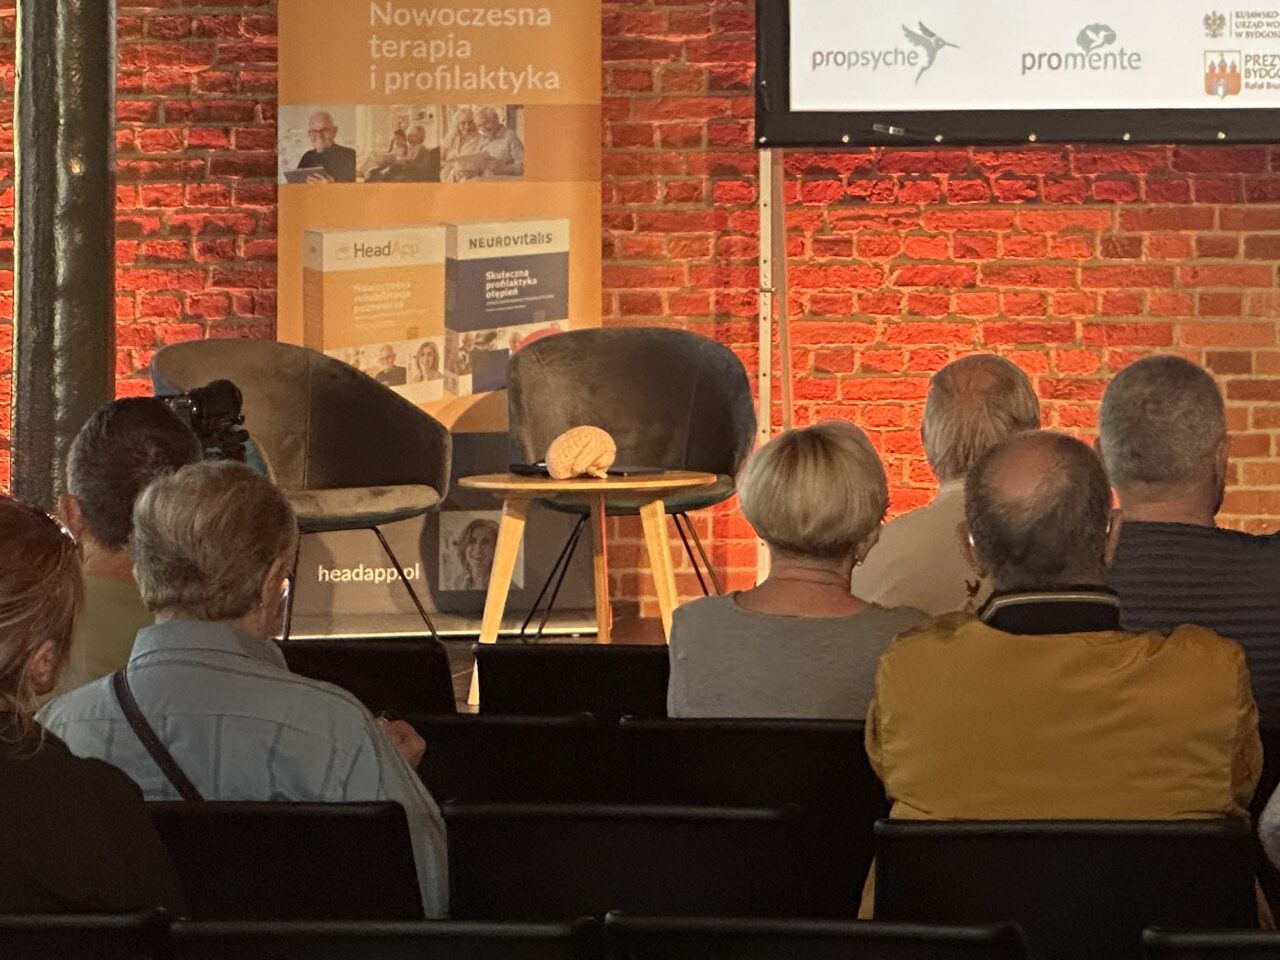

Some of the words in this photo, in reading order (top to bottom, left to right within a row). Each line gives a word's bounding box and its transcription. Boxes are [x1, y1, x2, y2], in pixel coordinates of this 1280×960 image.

[369, 1, 551, 27] Nowoczesna
[369, 34, 472, 62] terapia
[812, 48, 919, 71] propsyche
[1021, 46, 1142, 76] promente
[369, 65, 376, 89] i
[384, 65, 560, 95] profilaktyka
